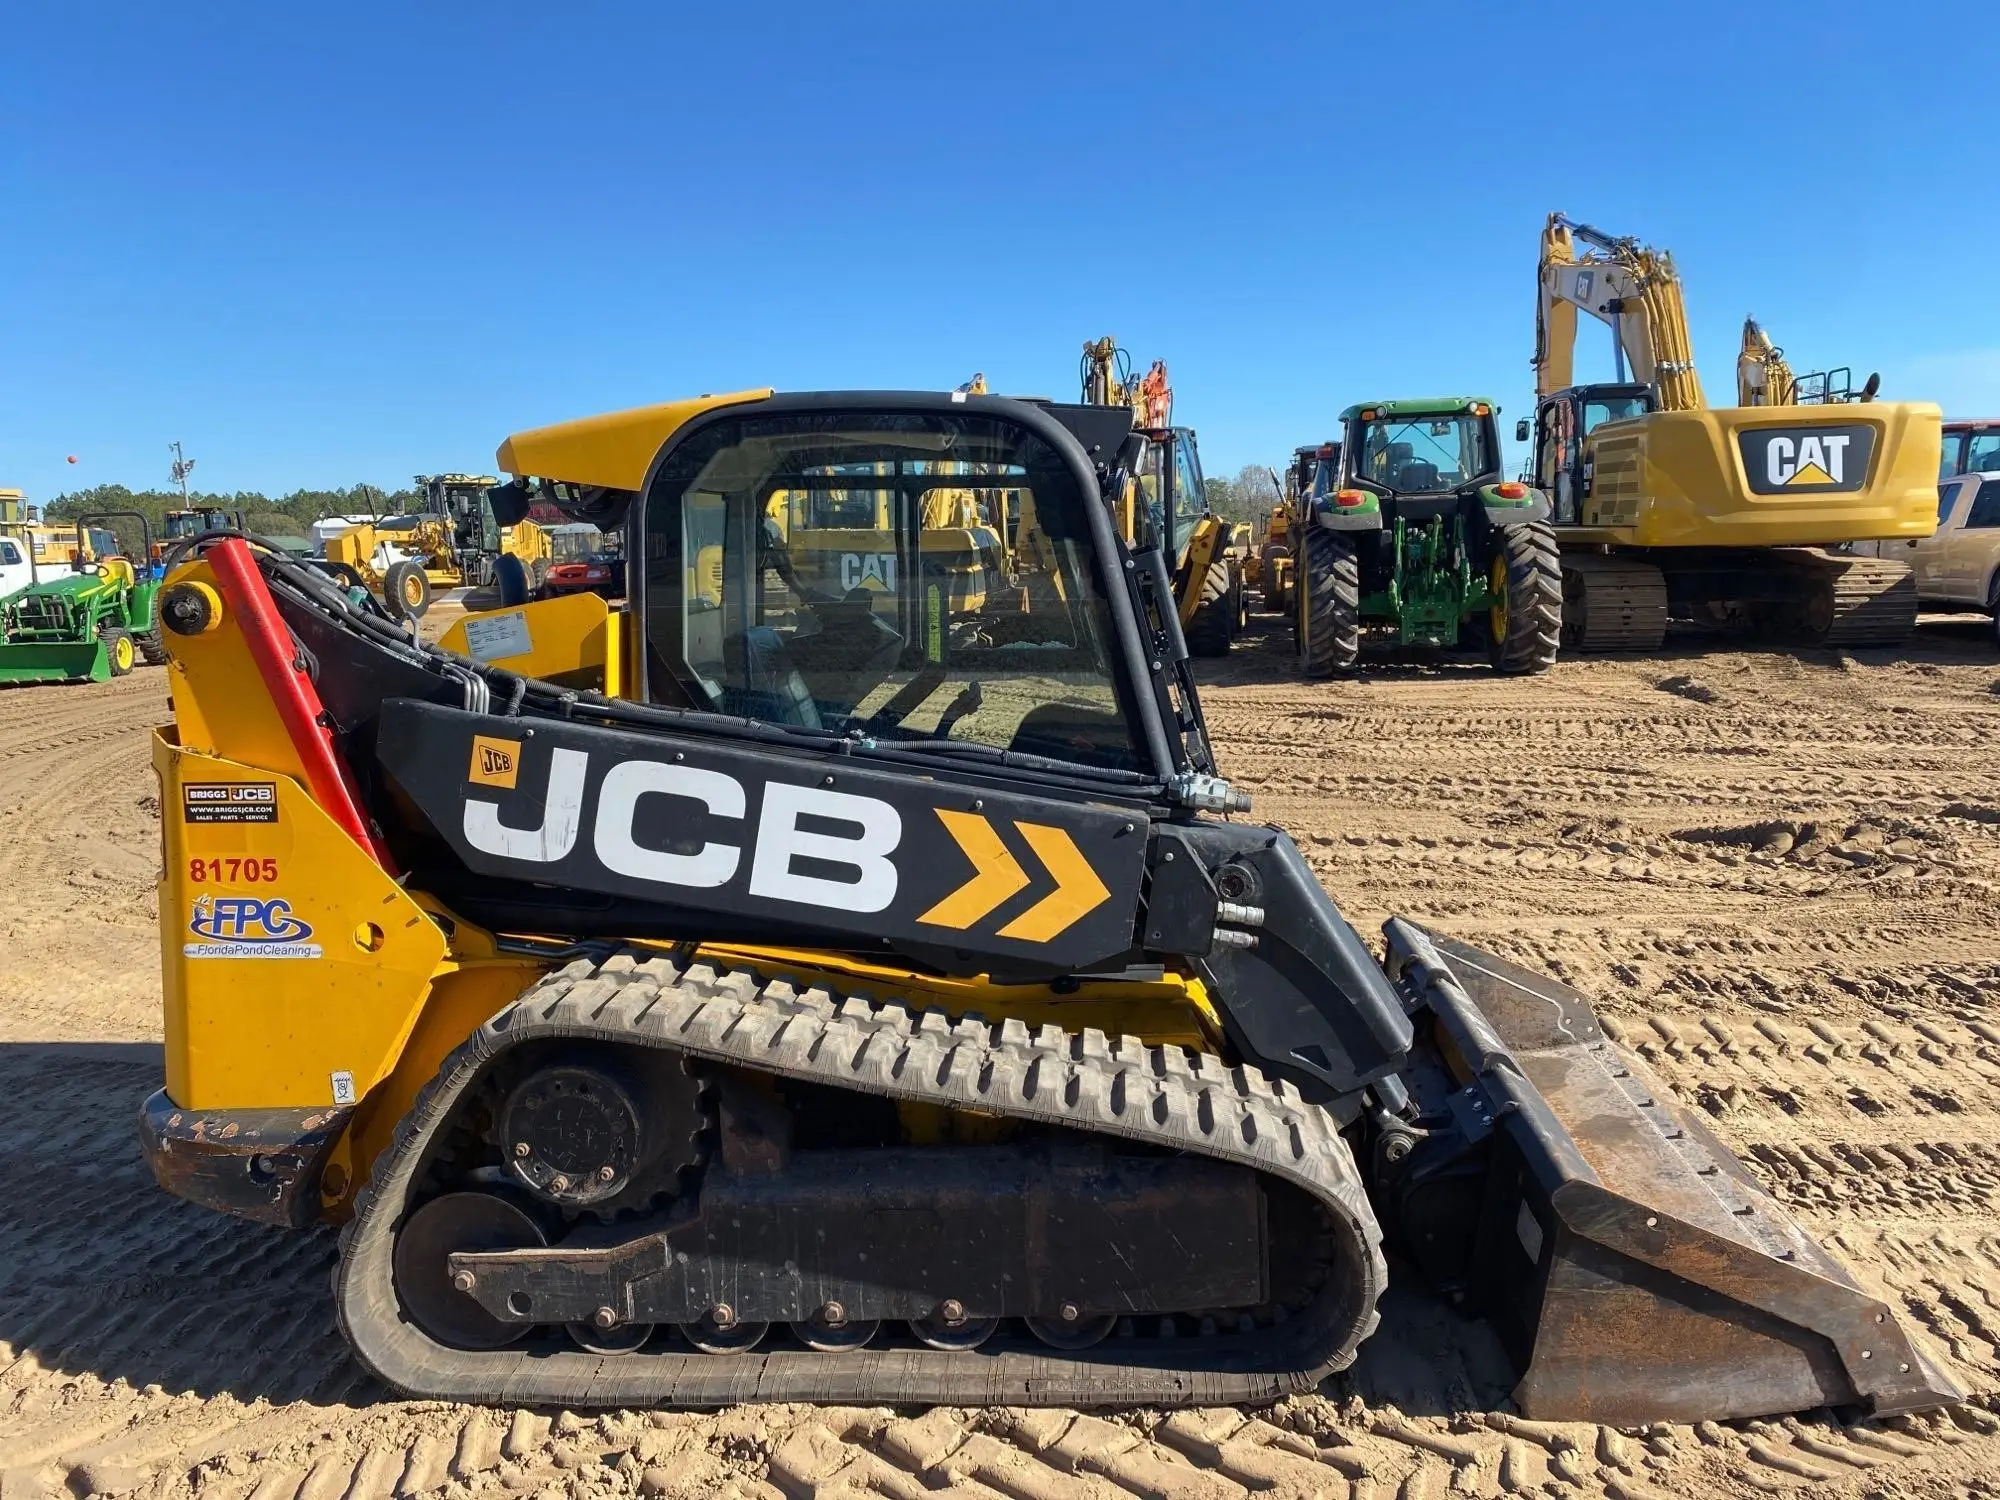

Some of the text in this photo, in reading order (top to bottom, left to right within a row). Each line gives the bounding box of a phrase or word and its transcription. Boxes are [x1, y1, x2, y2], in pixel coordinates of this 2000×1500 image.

[1767, 435, 1850, 486] CAT
[841, 554, 897, 592] CAT
[483, 748, 511, 773] JCB
[189, 788, 272, 800] BRIGGS JCB
[189, 806, 273, 814] WWW.BRIGGSJCB.COM
[463, 748, 902, 913] JCB
[189, 858, 279, 883] 81705
[212, 899, 292, 936] FPC
